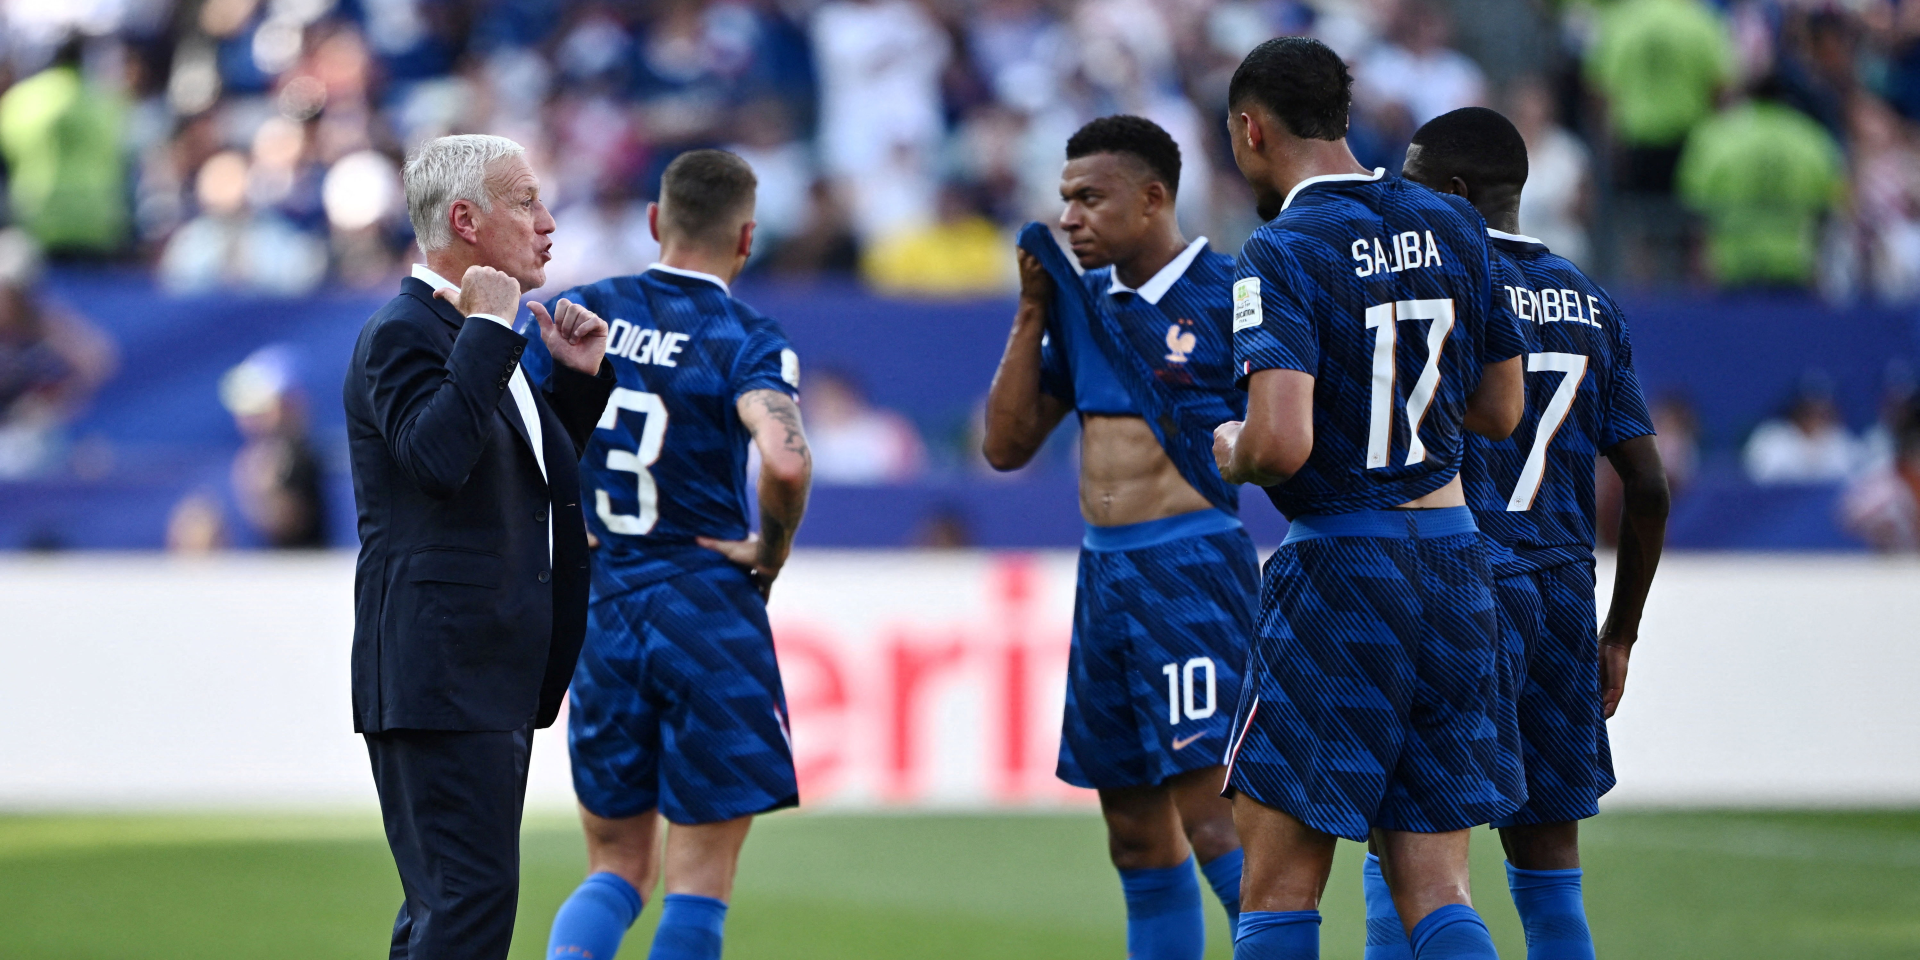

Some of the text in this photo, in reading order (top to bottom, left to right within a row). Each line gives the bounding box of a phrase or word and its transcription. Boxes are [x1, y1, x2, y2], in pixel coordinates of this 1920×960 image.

[1352, 229, 1442, 278] SAIBA
[605, 318, 690, 367] DIGNE
[1365, 298, 1455, 469] 17
[596, 386, 669, 536] 3
[1506, 352, 1588, 511] 7
[1163, 656, 1217, 725] 10
